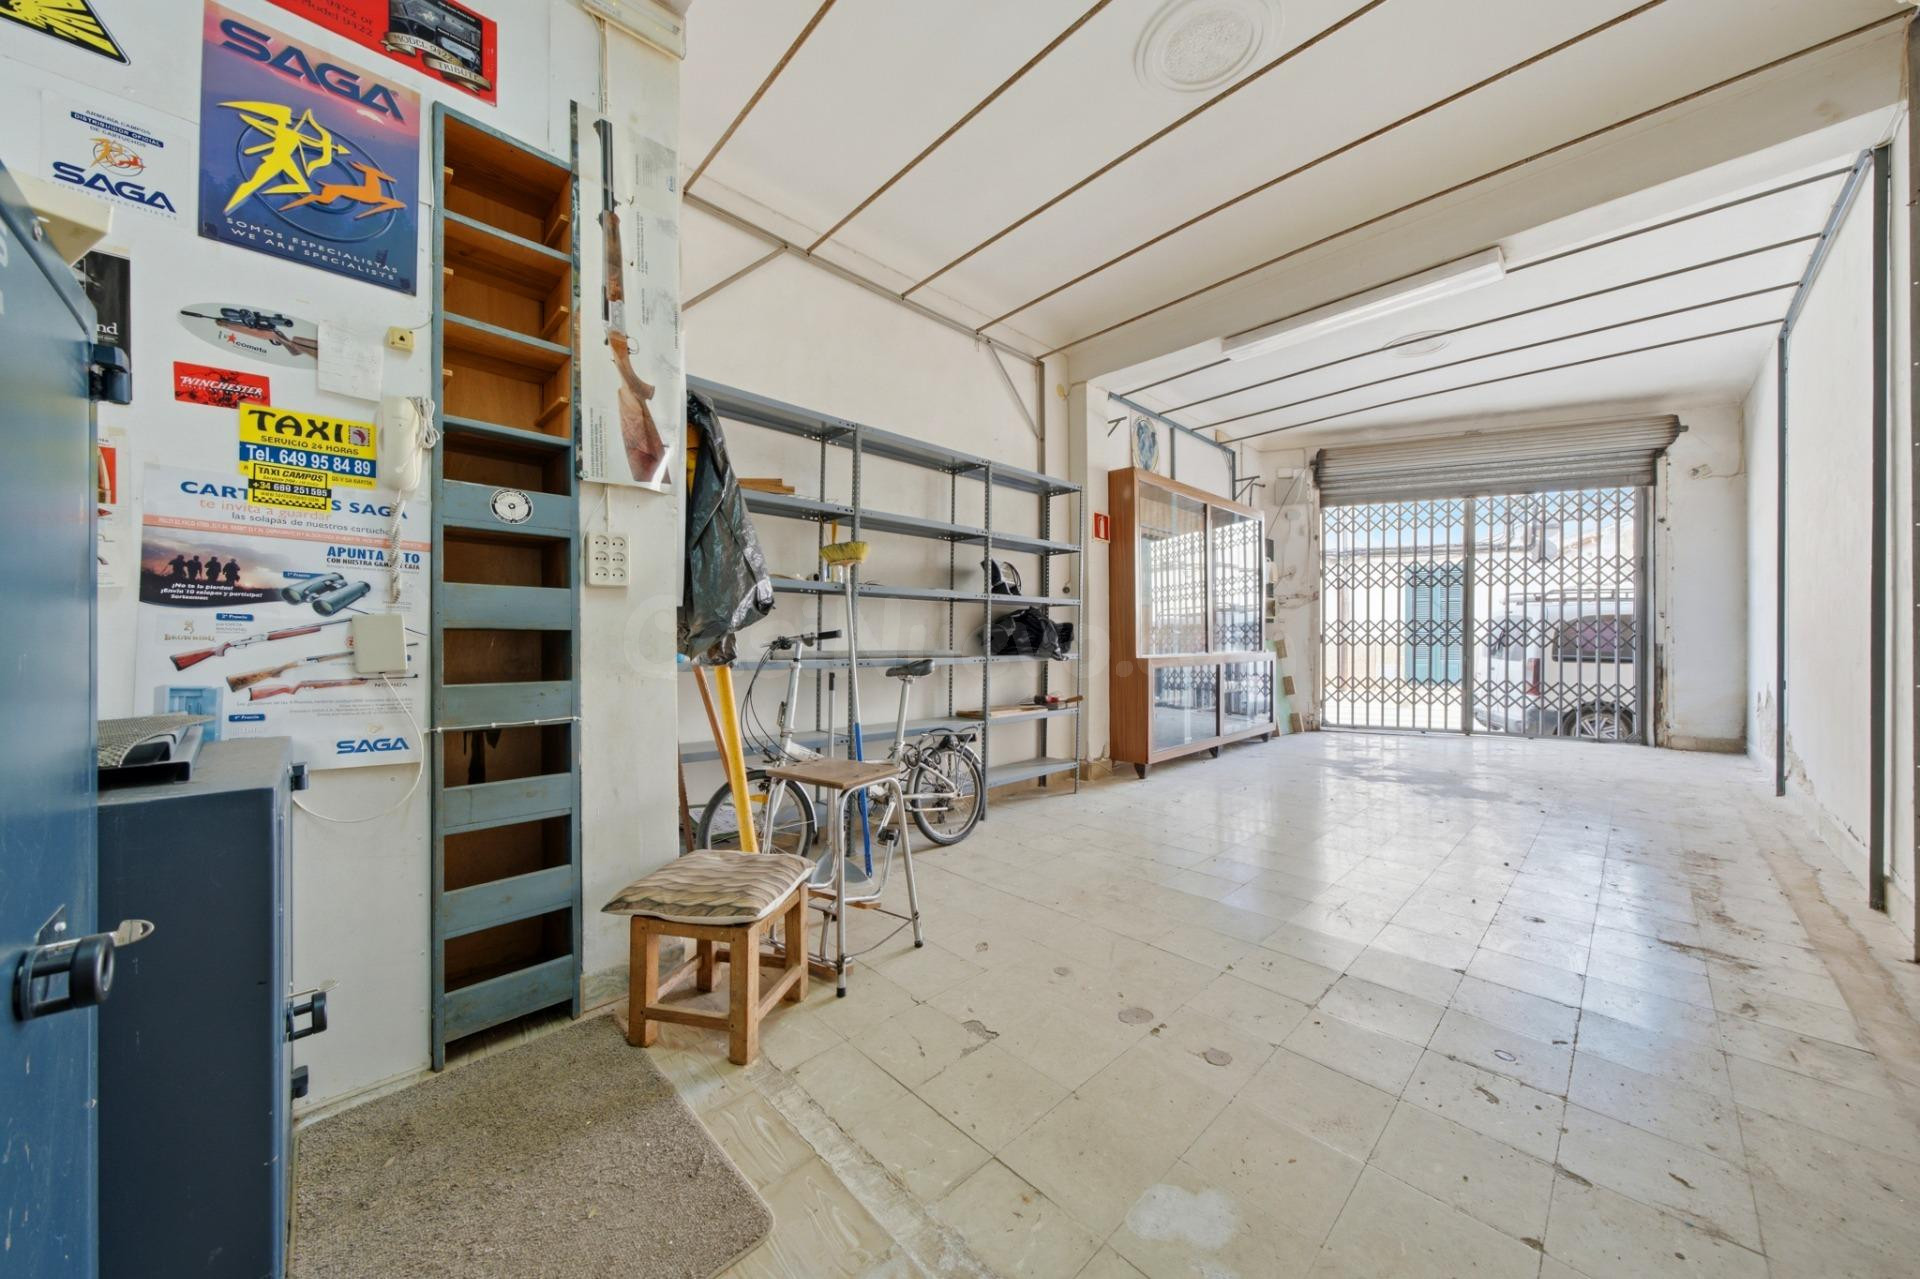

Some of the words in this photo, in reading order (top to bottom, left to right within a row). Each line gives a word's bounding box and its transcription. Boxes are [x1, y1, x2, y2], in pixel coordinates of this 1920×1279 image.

[390, 33, 426, 50] MODEL
[219, 19, 404, 121] SAGA
[438, 61, 481, 82] TRIBUTE
[74, 112, 130, 136] DISTRIBUIDOR
[131, 131, 162, 147] OFICIAL
[52, 161, 176, 213] SAGA
[226, 217, 284, 239] SOMOS
[291, 236, 398, 274] ESPECIALISTAS
[230, 227, 256, 240] WE
[265, 238, 295, 251] ARE
[303, 249, 394, 280] SPECIALISTS
[235, 340, 268, 355] cometa
[179, 375, 264, 397] WINCHESTER
[248, 410, 343, 443] TAXI
[260, 434, 309, 448] SERVICIO
[325, 444, 359, 455] HORAS
[246, 444, 274, 463] Tel.
[279, 449, 307, 467] 649
[311, 453, 329, 470] 95
[332, 456, 351, 473] 84
[354, 459, 371, 475] 89
[252, 481, 271, 490] +34
[258, 467, 280, 476] TAXI
[281, 469, 324, 483] CAMPOS
[349, 502, 408, 519] SAG
[232, 512, 246, 521] las
[249, 513, 287, 525] solapas
[290, 517, 303, 526] de
[306, 521, 348, 532] nuestros
[326, 546, 385, 561] APUNTA
[326, 557, 341, 565] CON
[336, 737, 410, 754] SAGA
